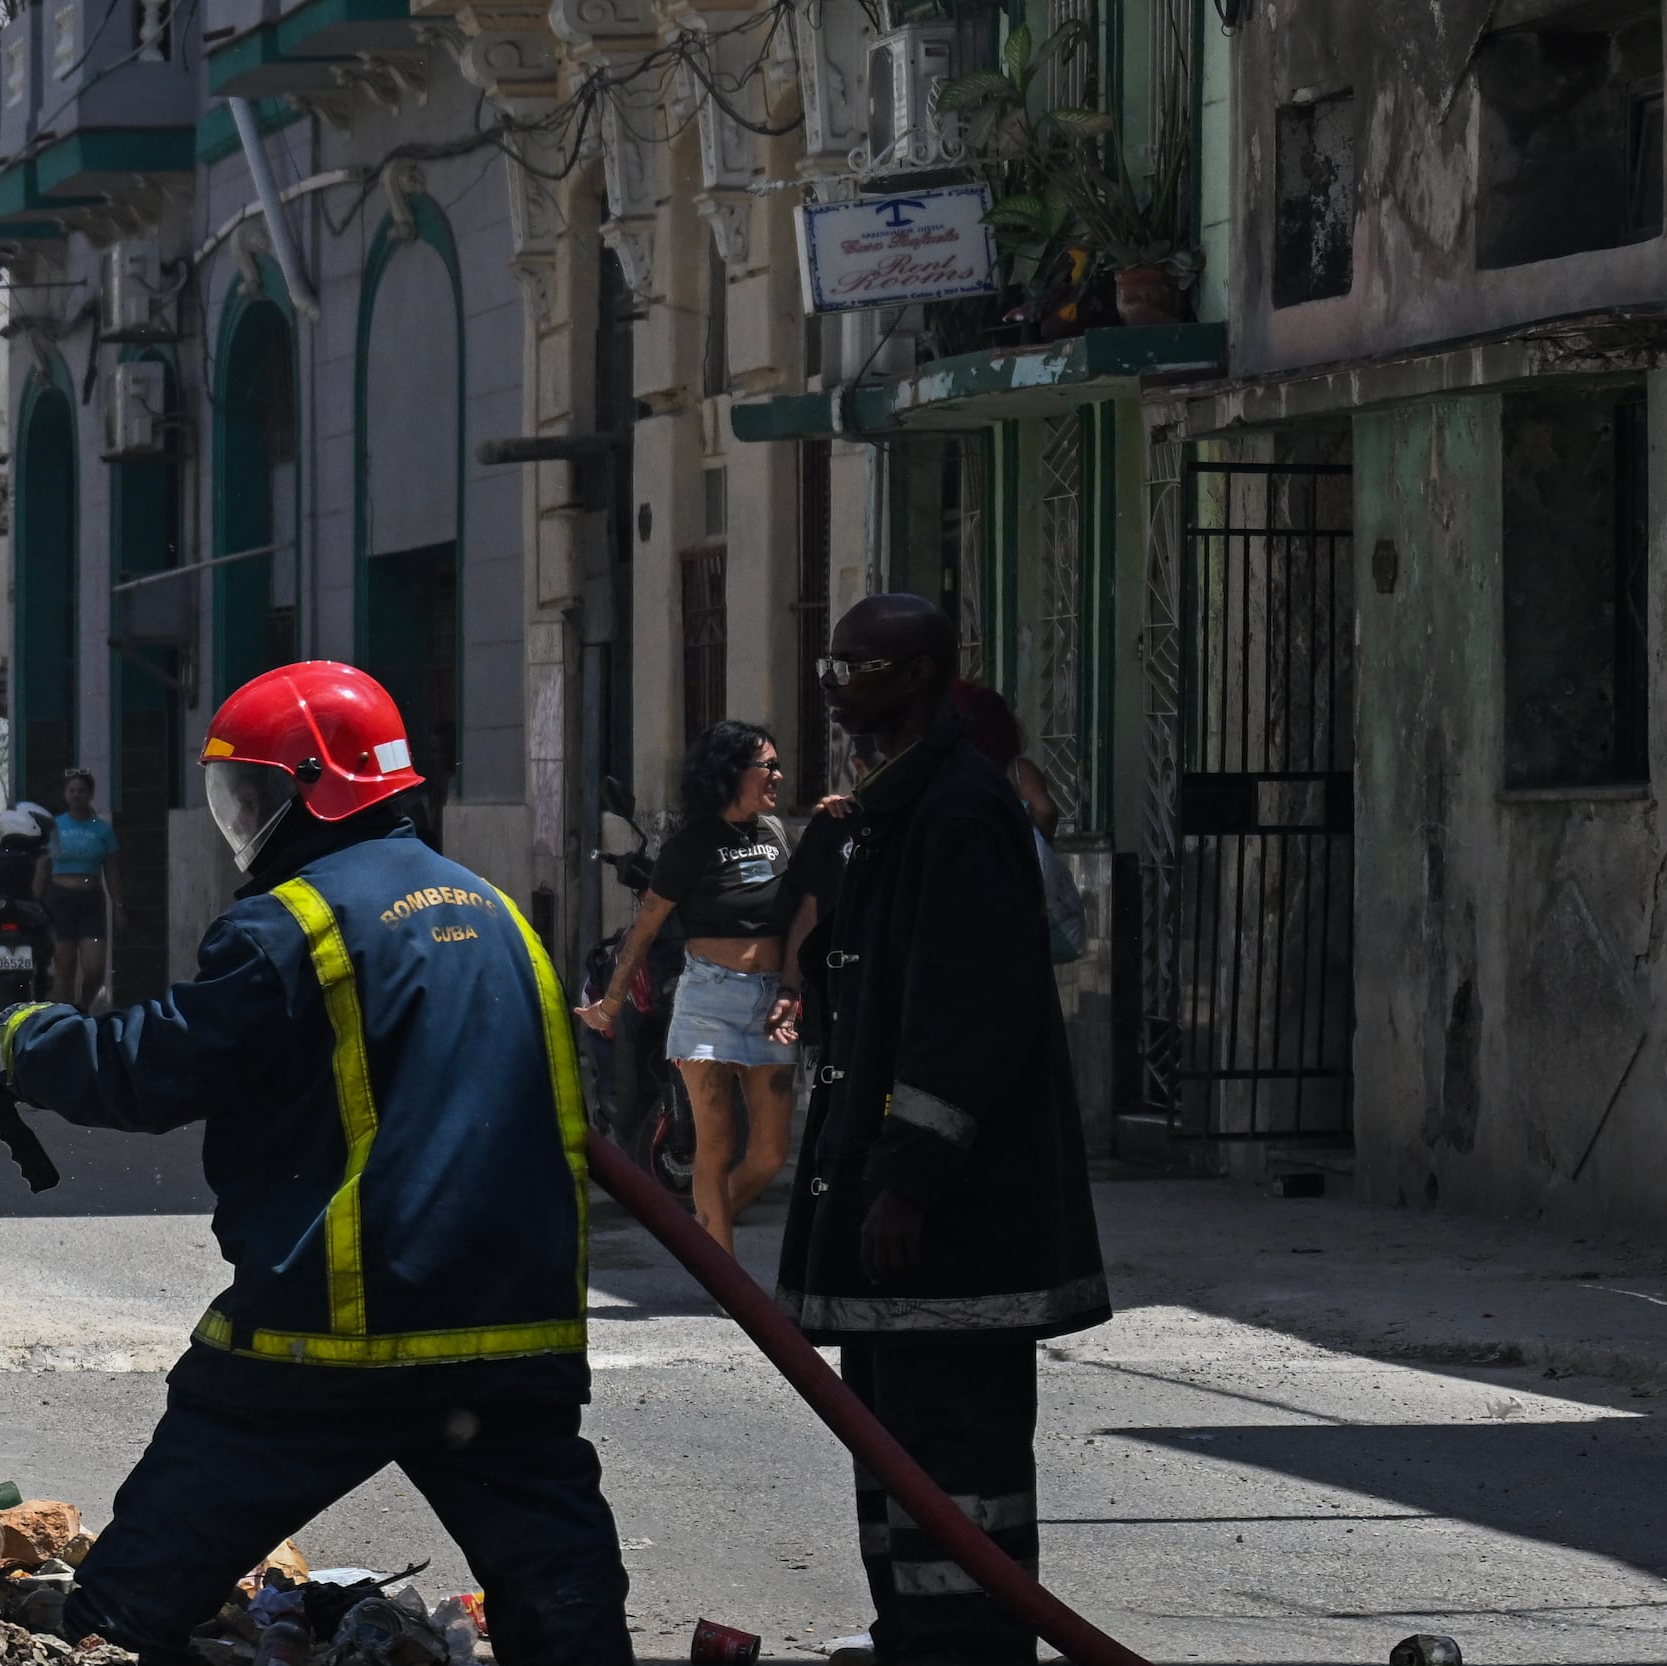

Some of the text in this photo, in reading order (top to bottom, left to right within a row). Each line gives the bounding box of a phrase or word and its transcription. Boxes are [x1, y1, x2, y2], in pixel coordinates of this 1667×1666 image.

[877, 255, 956, 278] Rent
[830, 266, 973, 295] Rooms
[717, 843, 779, 863] Feelings
[380, 886, 500, 932] BOMBEROS
[431, 923, 478, 943] CUBA
